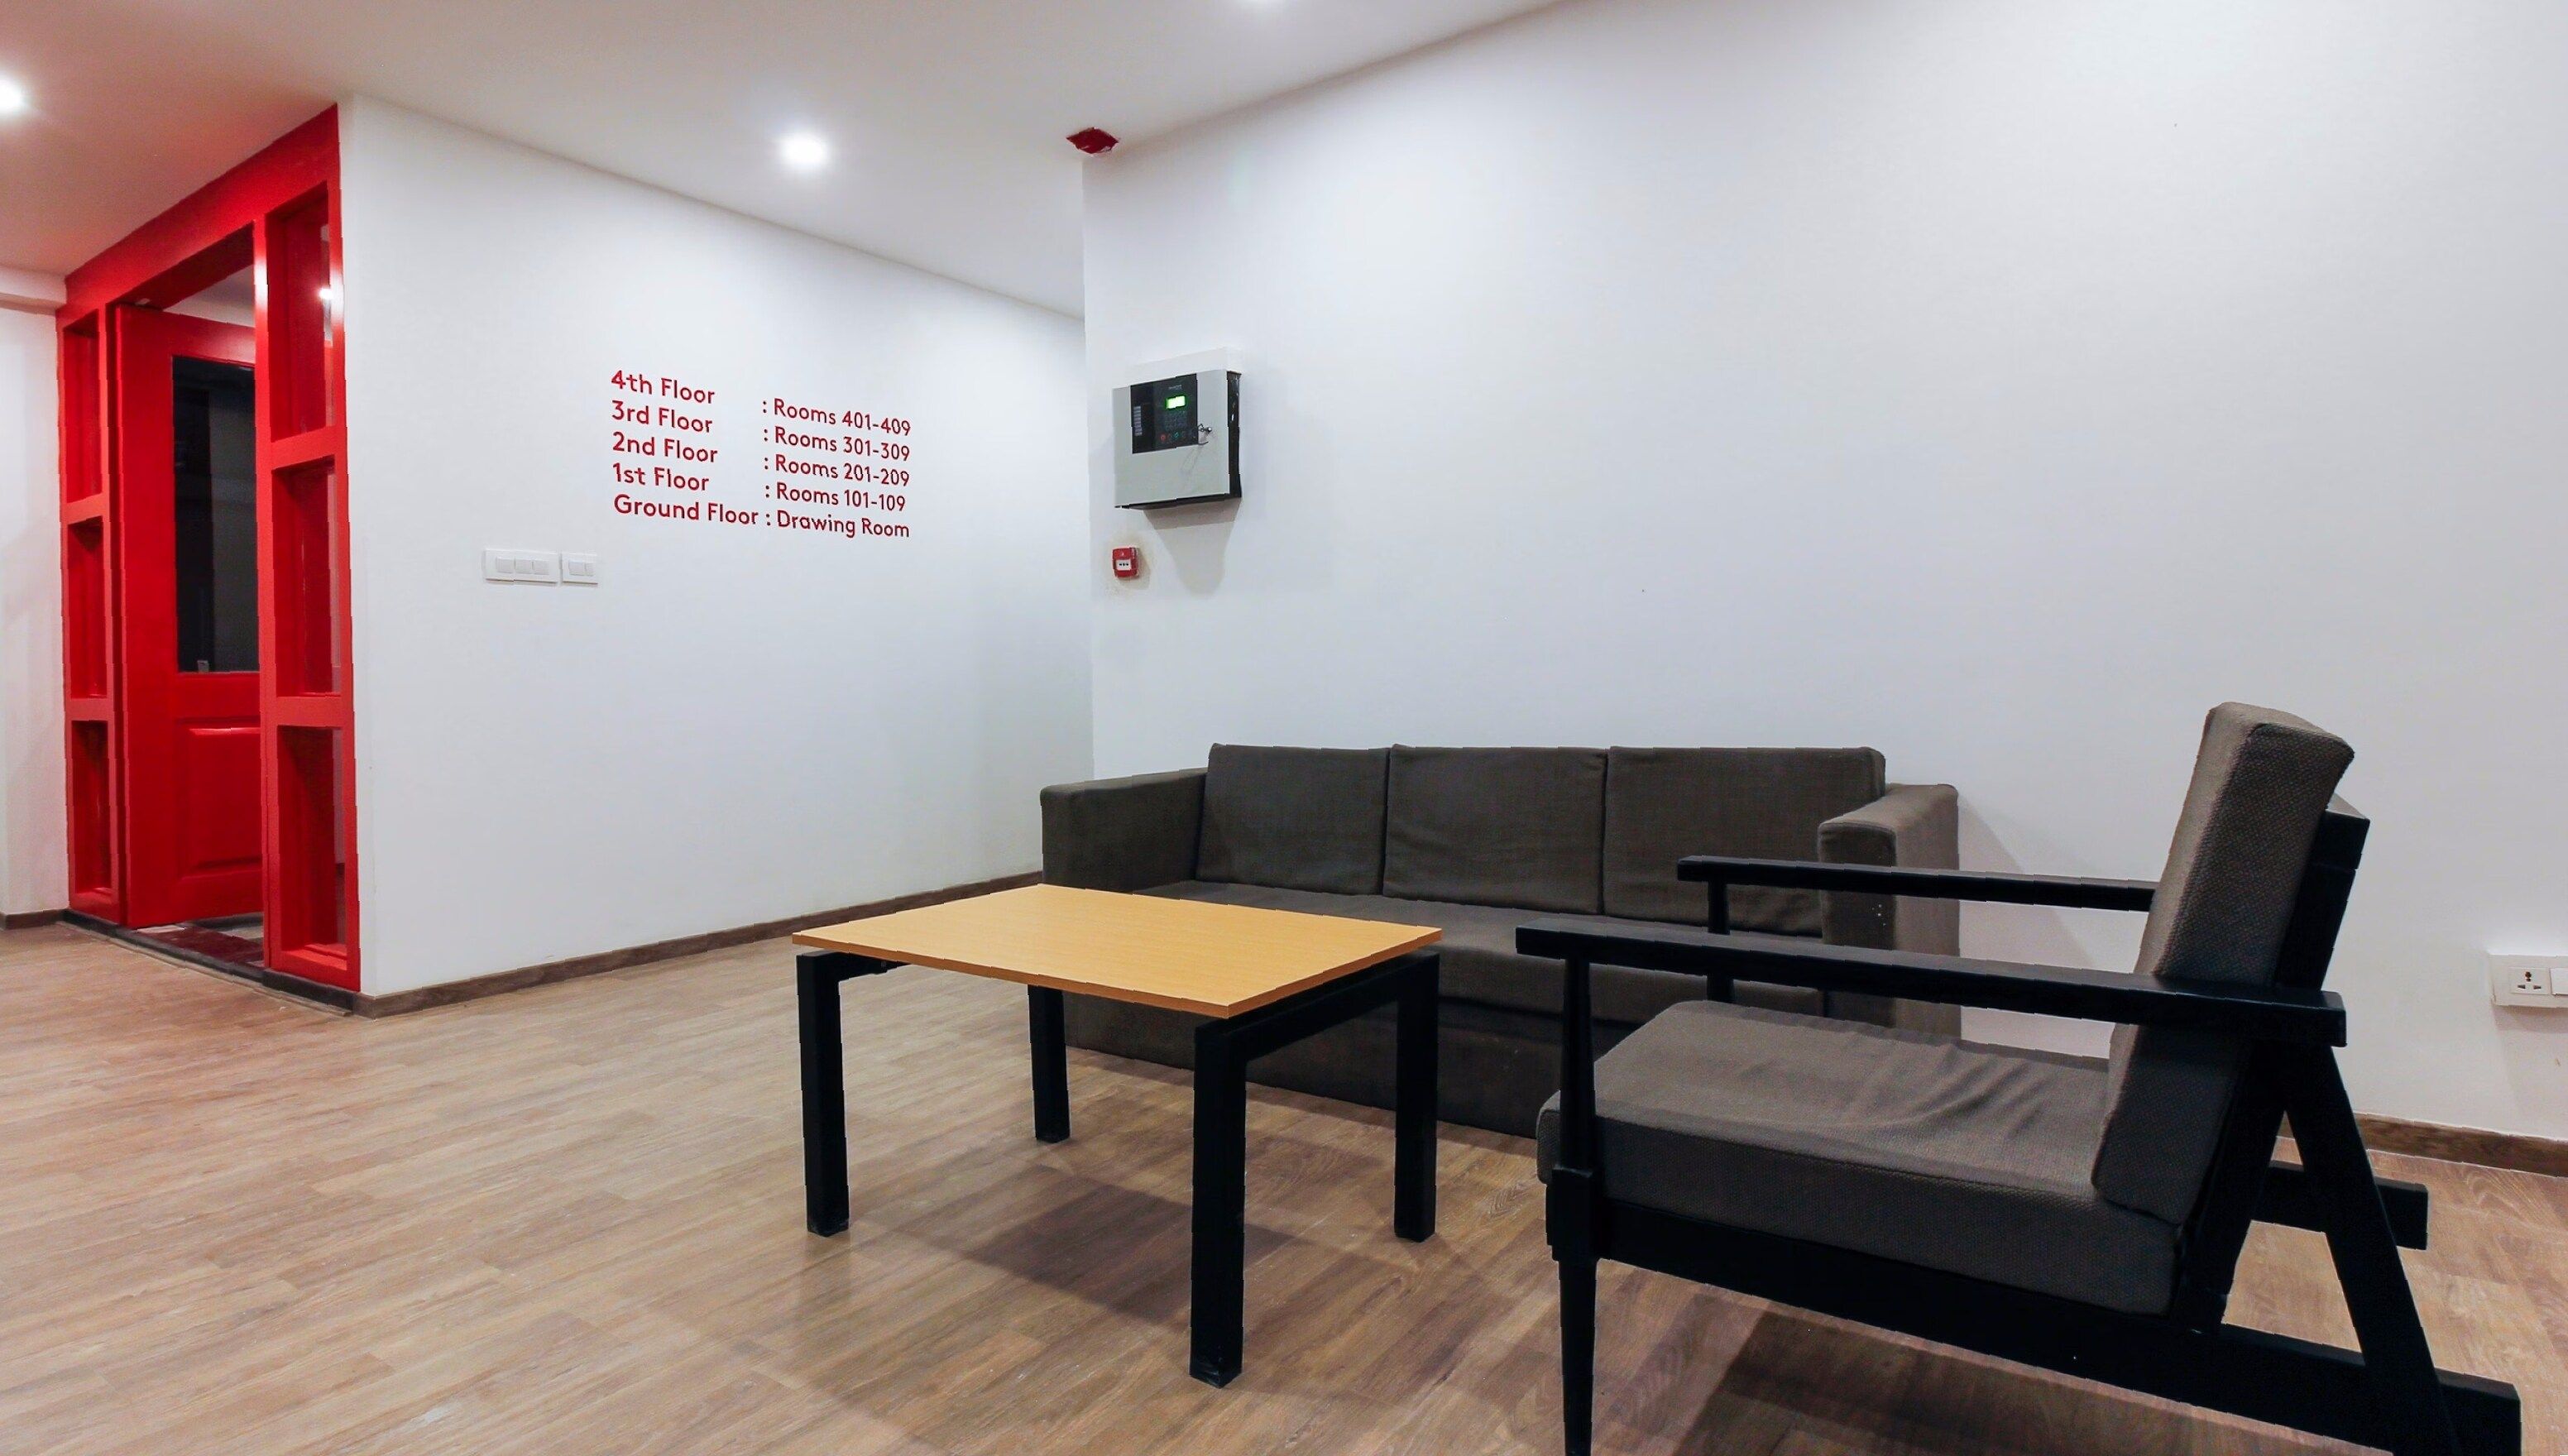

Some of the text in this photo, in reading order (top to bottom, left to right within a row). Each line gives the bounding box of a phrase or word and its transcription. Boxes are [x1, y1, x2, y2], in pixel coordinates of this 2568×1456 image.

[611, 369, 653, 395] 4th
[660, 376, 716, 405] Floor
[774, 397, 836, 425] Rooms
[841, 410, 912, 437] 401-409
[611, 400, 650, 425] 3rd
[658, 406, 713, 433] Floor
[774, 425, 837, 453] Rooms
[842, 435, 911, 462] 301-309
[612, 430, 656, 457] 2nd
[664, 438, 719, 463] Floor
[775, 453, 839, 479] Rooms
[843, 462, 910, 487] 201-209
[612, 462, 647, 486] 1st
[654, 466, 710, 491] Floor
[776, 481, 840, 505] Rooms
[843, 489, 906, 512] 101-109
[613, 493, 700, 521] Ground
[707, 501, 759, 525] Floor
[776, 509, 856, 539] Drawing
[860, 517, 910, 539] Room
